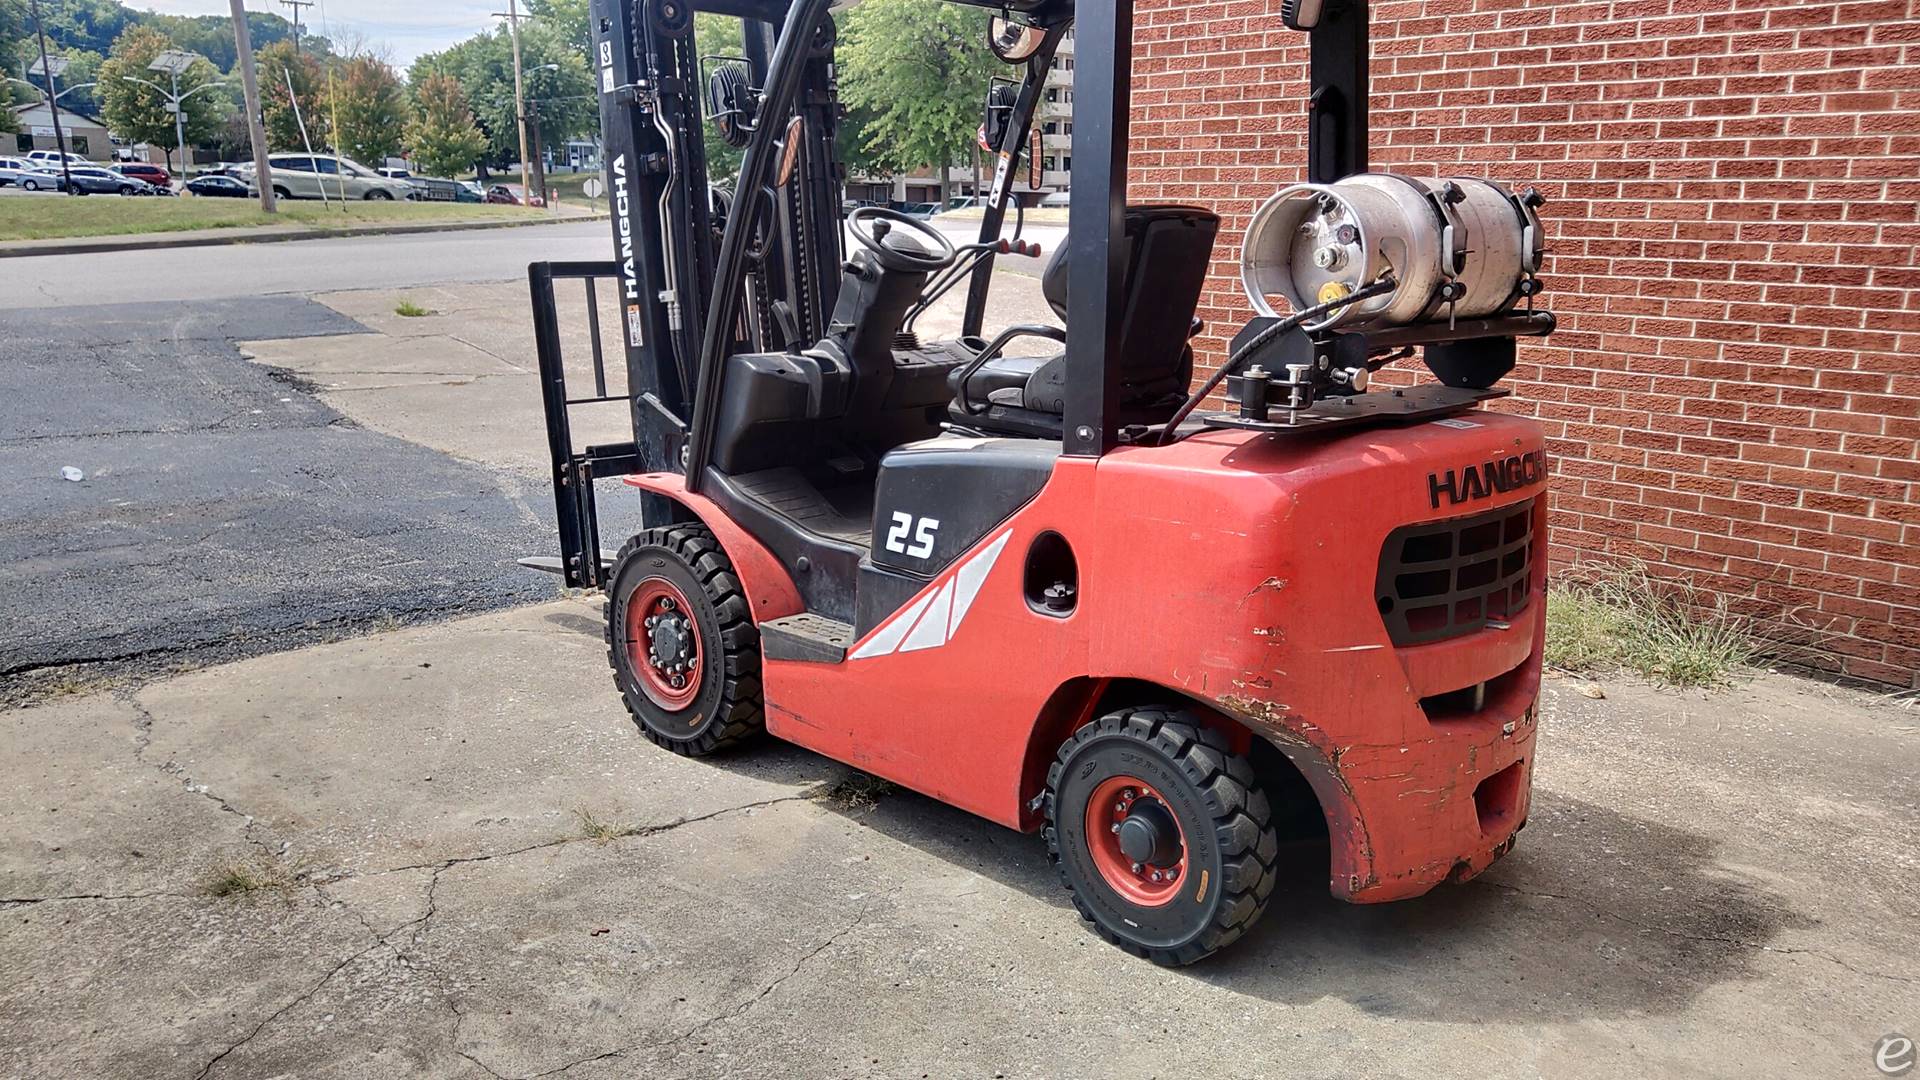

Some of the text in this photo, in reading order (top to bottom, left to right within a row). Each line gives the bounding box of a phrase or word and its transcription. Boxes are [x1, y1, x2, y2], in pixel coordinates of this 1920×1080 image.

[613, 153, 638, 299] HANGCHA
[1427, 449, 1548, 509] HANGCH
[885, 511, 939, 559] 25
